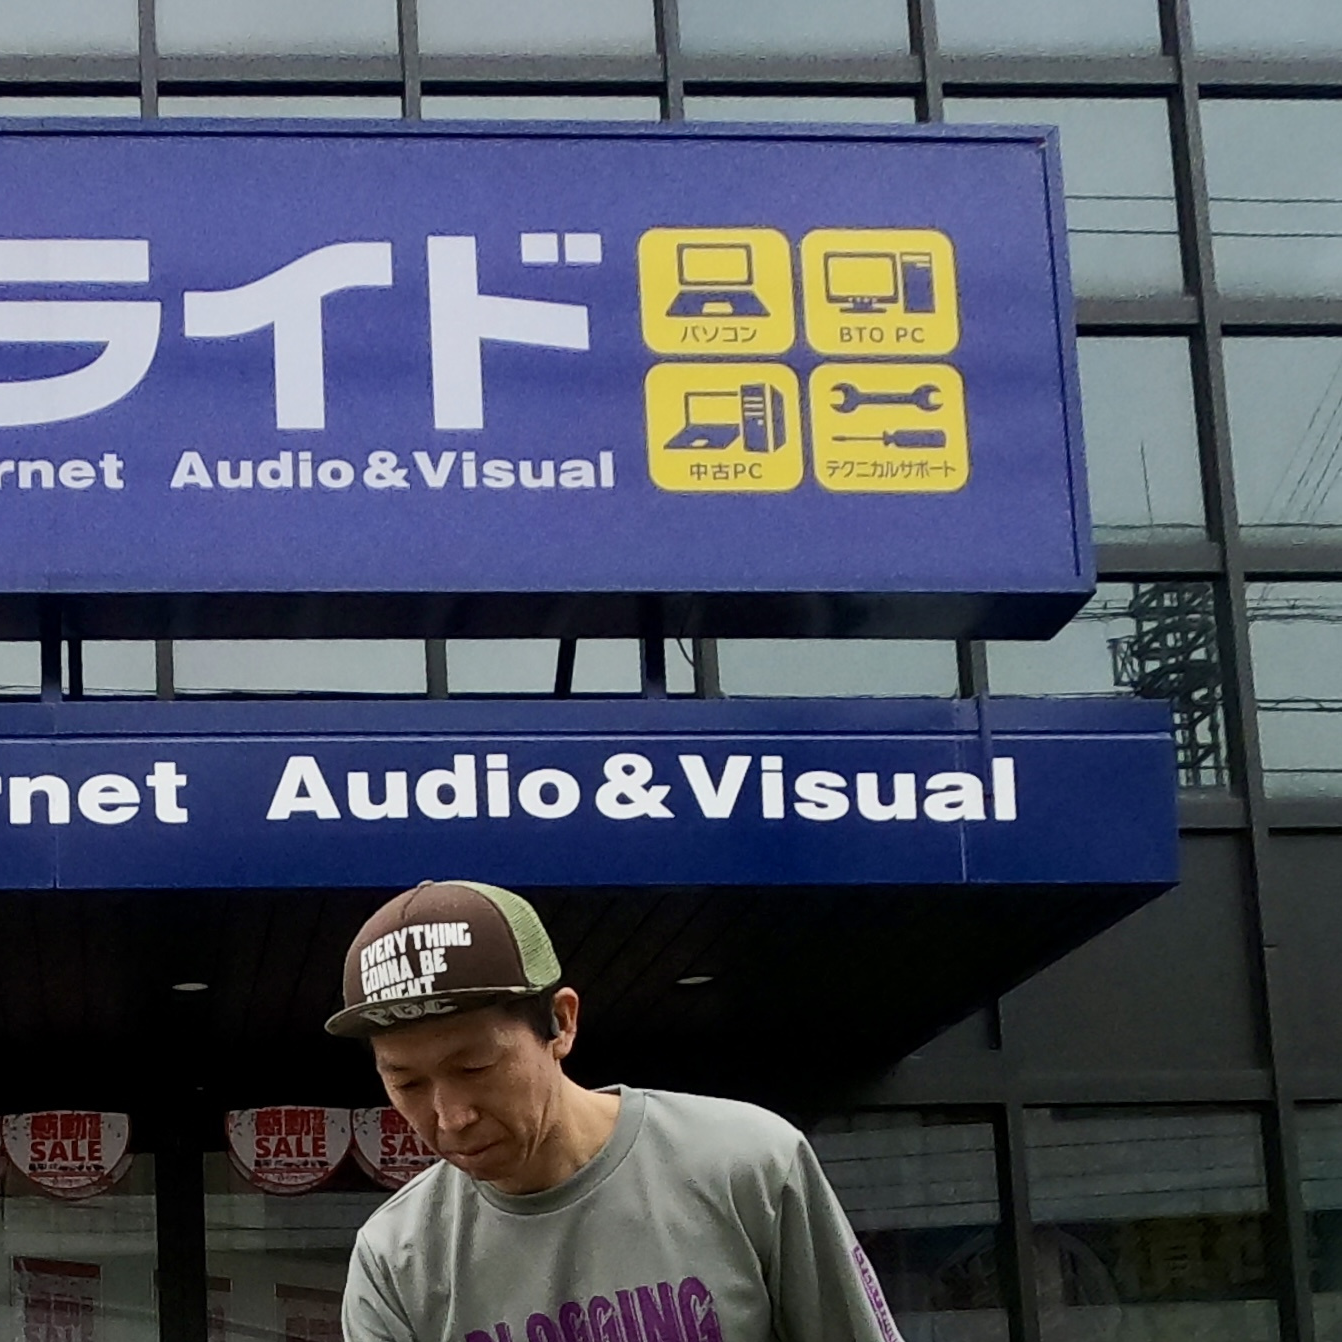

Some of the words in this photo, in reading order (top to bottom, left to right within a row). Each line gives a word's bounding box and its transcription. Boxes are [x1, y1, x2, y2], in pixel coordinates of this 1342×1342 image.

[680, 325, 757, 343] パソコン
[840, 326, 884, 343] BTO
[895, 326, 925, 343] PC
[689, 463, 763, 481] 中古PC
[826, 460, 956, 479] テクニカルサポート
[360, 922, 472, 972] EVERYTHING
[361, 958, 414, 995] GONNA
[419, 948, 448, 975] BE
[30, 1140, 101, 1162] SALE
[255, 1137, 326, 1158] SALE
[380, 1136, 436, 1156] SAL
